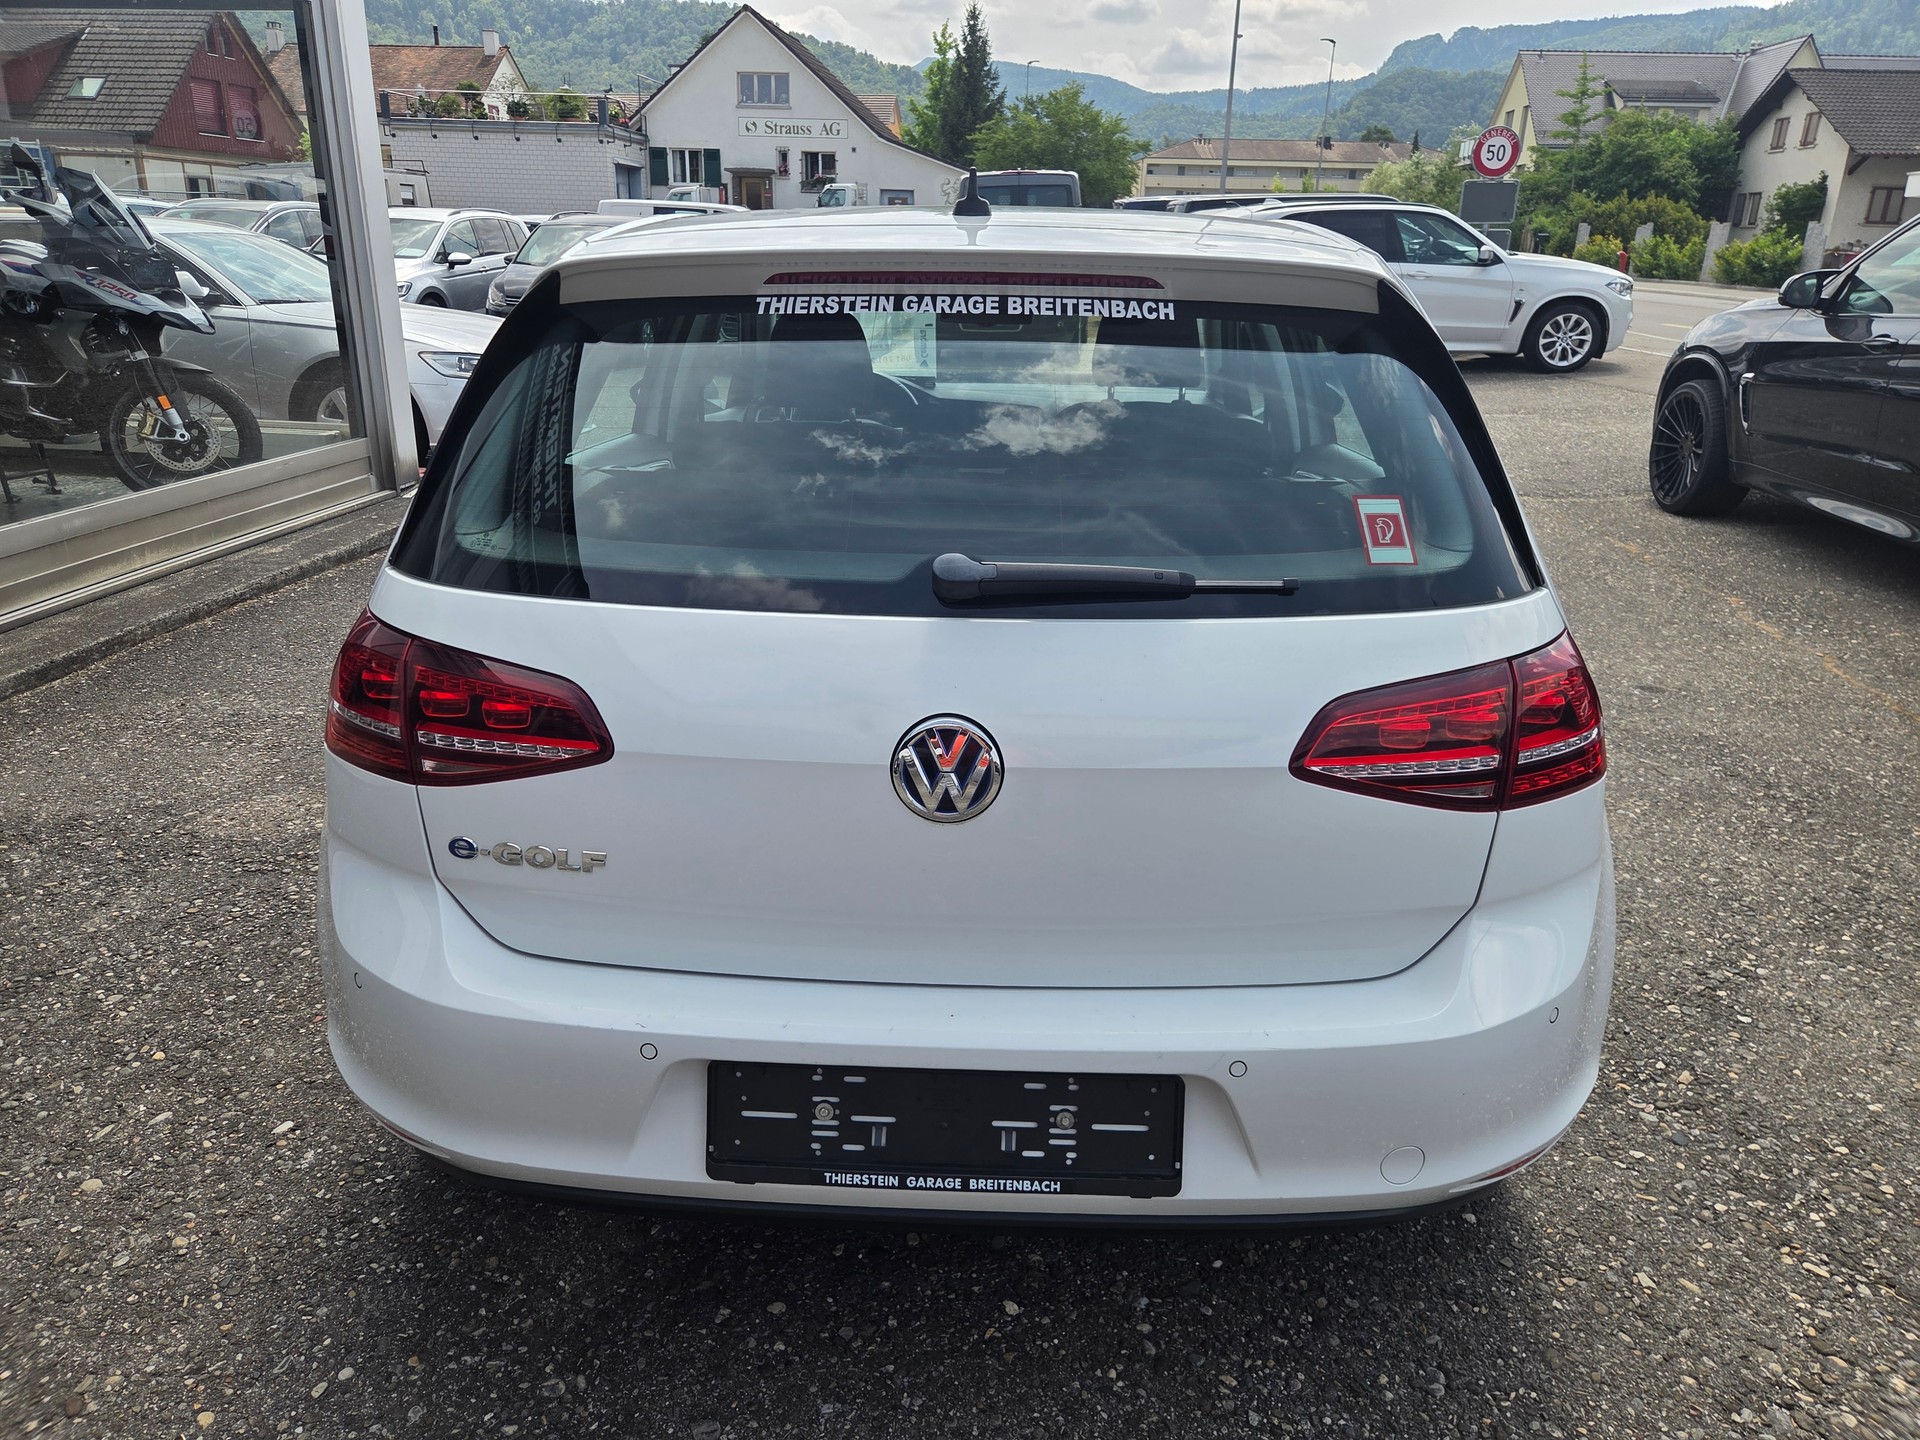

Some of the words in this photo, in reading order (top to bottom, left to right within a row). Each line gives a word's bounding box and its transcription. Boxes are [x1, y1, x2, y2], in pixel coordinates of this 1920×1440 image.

[764, 120, 813, 136] Strauss
[819, 121, 842, 137] AG
[1480, 128, 1518, 146] GENERELL
[1486, 144, 1506, 162] 50
[755, 295, 895, 315] THIERSTEIN
[902, 295, 1000, 316] GARAGE
[1007, 296, 1176, 321] BREITENBACH
[891, 714, 1003, 822] VW
[448, 835, 607, 873] e-GOLF
[824, 1172, 899, 1187] THIERSTEIN
[906, 1176, 962, 1190] GARAGE
[969, 1178, 1061, 1193] BREITENBACH
